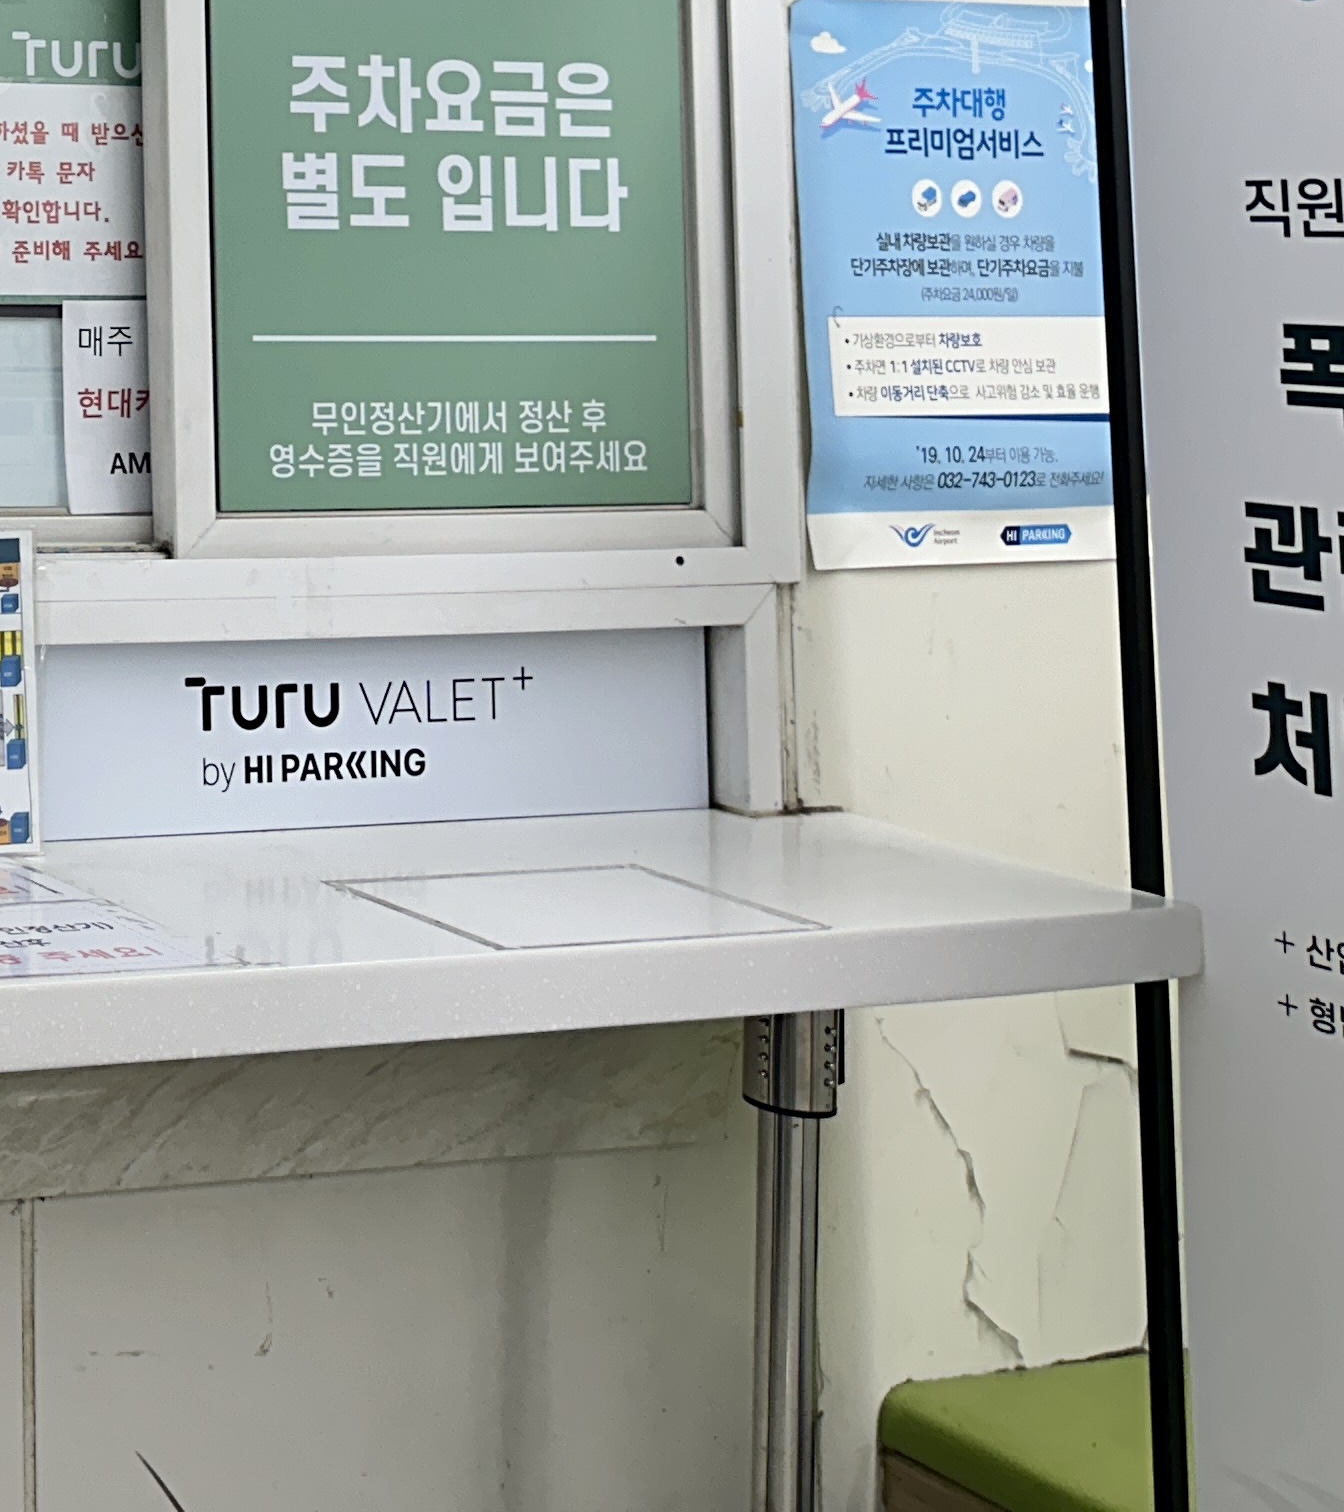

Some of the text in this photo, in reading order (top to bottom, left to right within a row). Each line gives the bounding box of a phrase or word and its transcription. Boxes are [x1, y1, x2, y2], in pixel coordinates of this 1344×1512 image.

[289, 54, 613, 138] 주차요금은
[912, 87, 1007, 119] 주차대행
[61, 120, 79, 143] 때
[884, 128, 1045, 161] 프리미엄서비스
[7, 160, 96, 183] 카톡 문자
[281, 152, 629, 233] 별도 입니다
[2, 200, 110, 225] 확인합니다.
[12, 240, 71, 263] 준비해
[84, 241, 144, 261] 주세요
[876, 232, 901, 251] 실내
[999, 235, 1021, 252] 경우
[850, 258, 925, 277] 단기주차장에
[977, 258, 1060, 278] 단기주차요금을
[78, 326, 134, 357] 매주
[938, 333, 983, 348] 차량보호
[910, 358, 943, 375] 설치된
[945, 358, 987, 374] CCTV로
[1035, 358, 1056, 374] 보관
[880, 385, 925, 401] 이동거리
[926, 384, 970, 401] 단축으로
[311, 399, 607, 436] 무인정산기에서 정산 후
[269, 438, 648, 478] 영수증을 직원에게 보여주세요
[1009, 448, 1031, 464] 이용
[1244, 501, 1344, 612] 관
[202, 758, 235, 792] by
[1310, 997, 1344, 1035] 형
